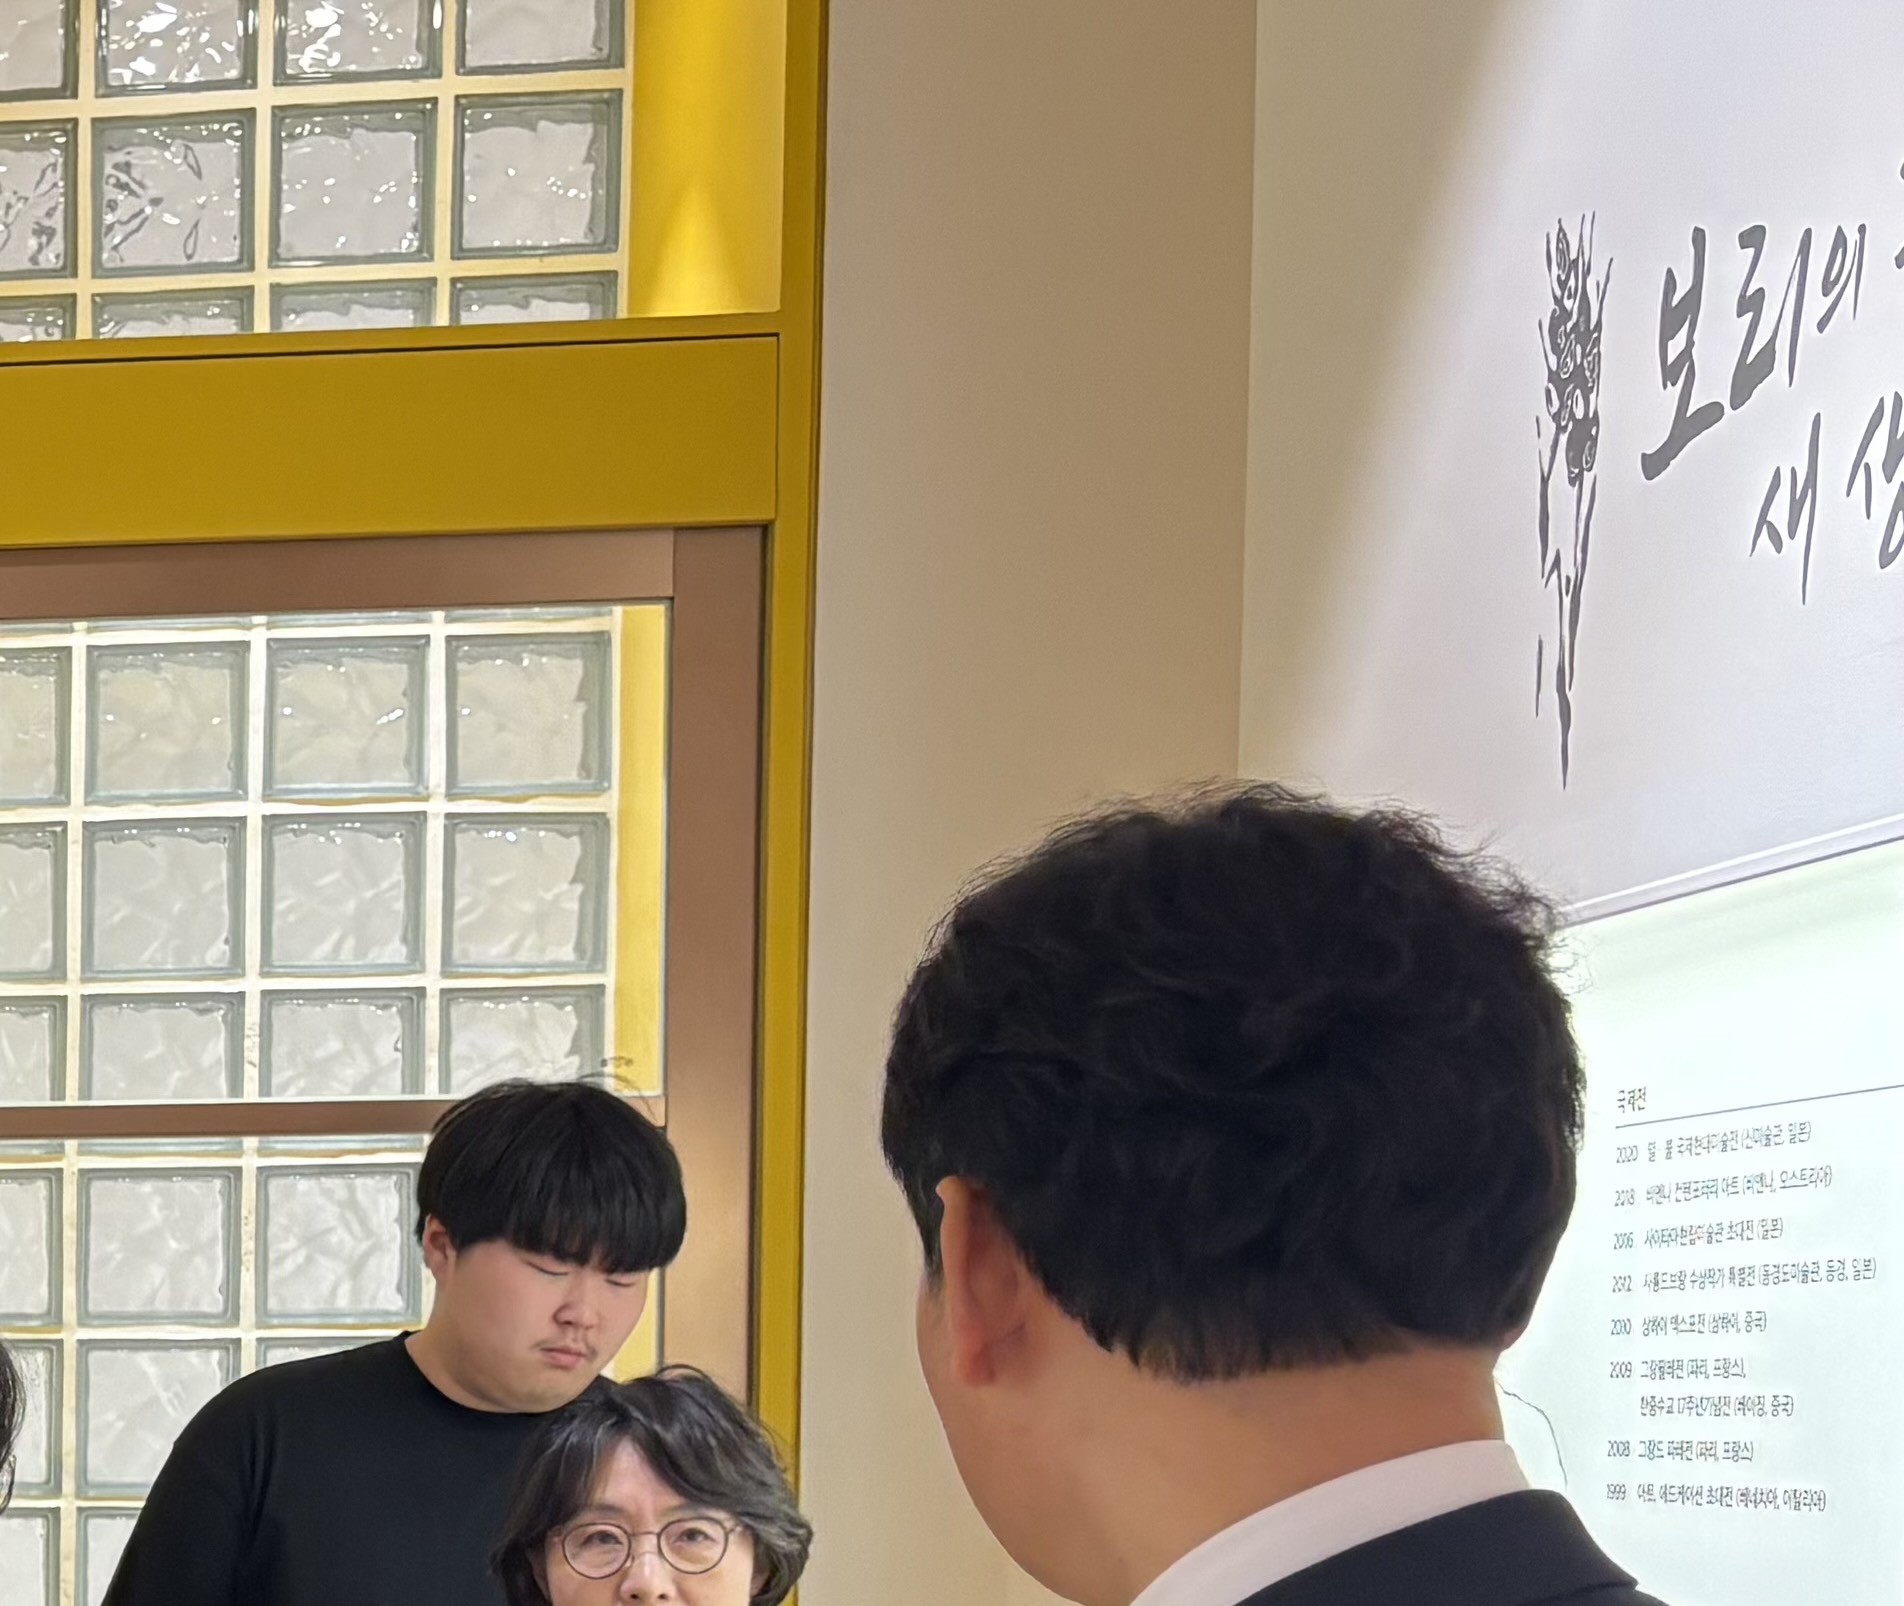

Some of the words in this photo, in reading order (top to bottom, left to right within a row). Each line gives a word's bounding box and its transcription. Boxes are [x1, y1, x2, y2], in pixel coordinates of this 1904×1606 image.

[1641, 223, 1867, 481] 보리의
[1617, 1086, 1647, 1114] 국제전
[1779, 1164, 1832, 1190] 오스트리아)
[1744, 1310, 1767, 1332] 중국)
[1771, 1395, 1794, 1417] 중국)
[1607, 1441, 1631, 1457] 2008
[1722, 1440, 1754, 1462] 프랑스)
[1607, 1484, 1626, 1501] 1999
